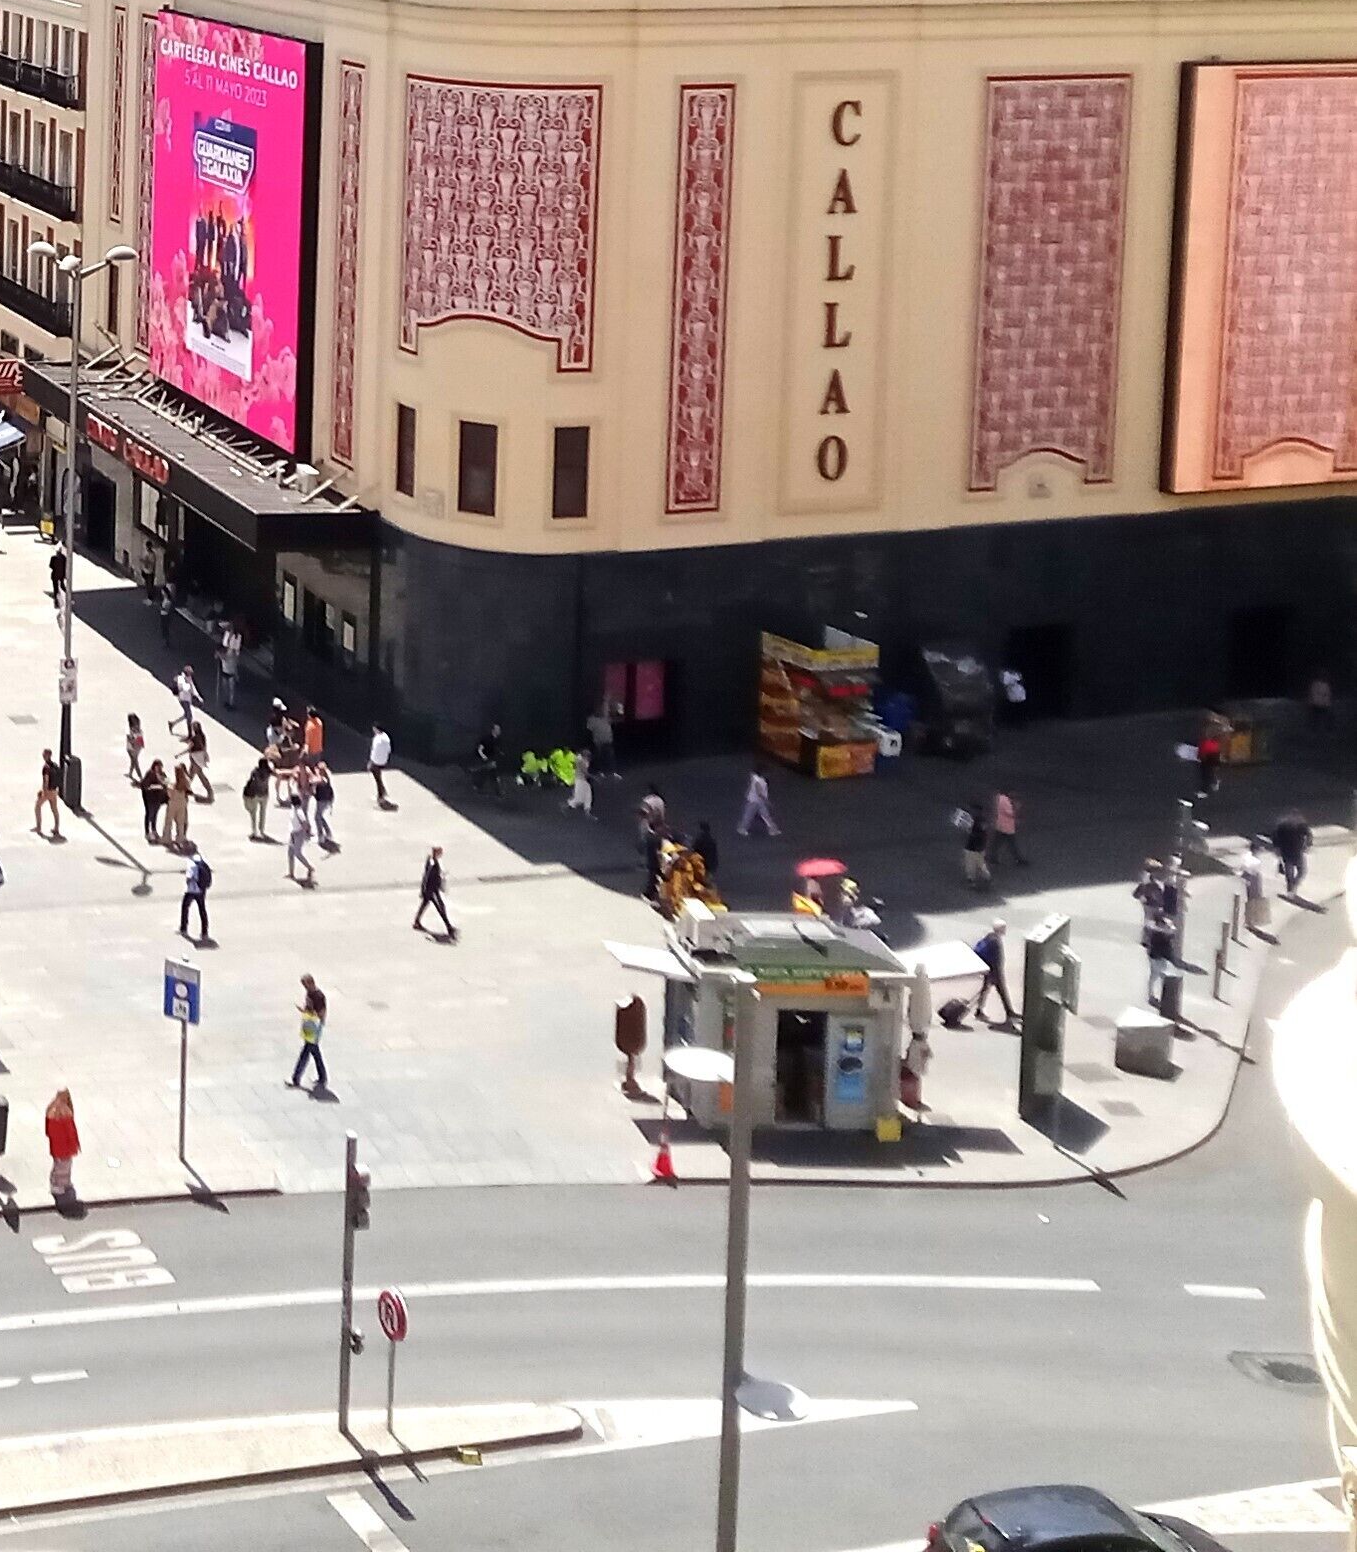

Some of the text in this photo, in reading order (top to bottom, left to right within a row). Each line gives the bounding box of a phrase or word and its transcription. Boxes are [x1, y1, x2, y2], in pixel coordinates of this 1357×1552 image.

[160, 38, 298, 89] CARTELERA CINES CALLAO
[215, 77, 242, 99] MAYO
[244, 86, 267, 108] 2023
[816, 99, 863, 482] CALLAO
[31, 1229, 176, 1294] BUS
